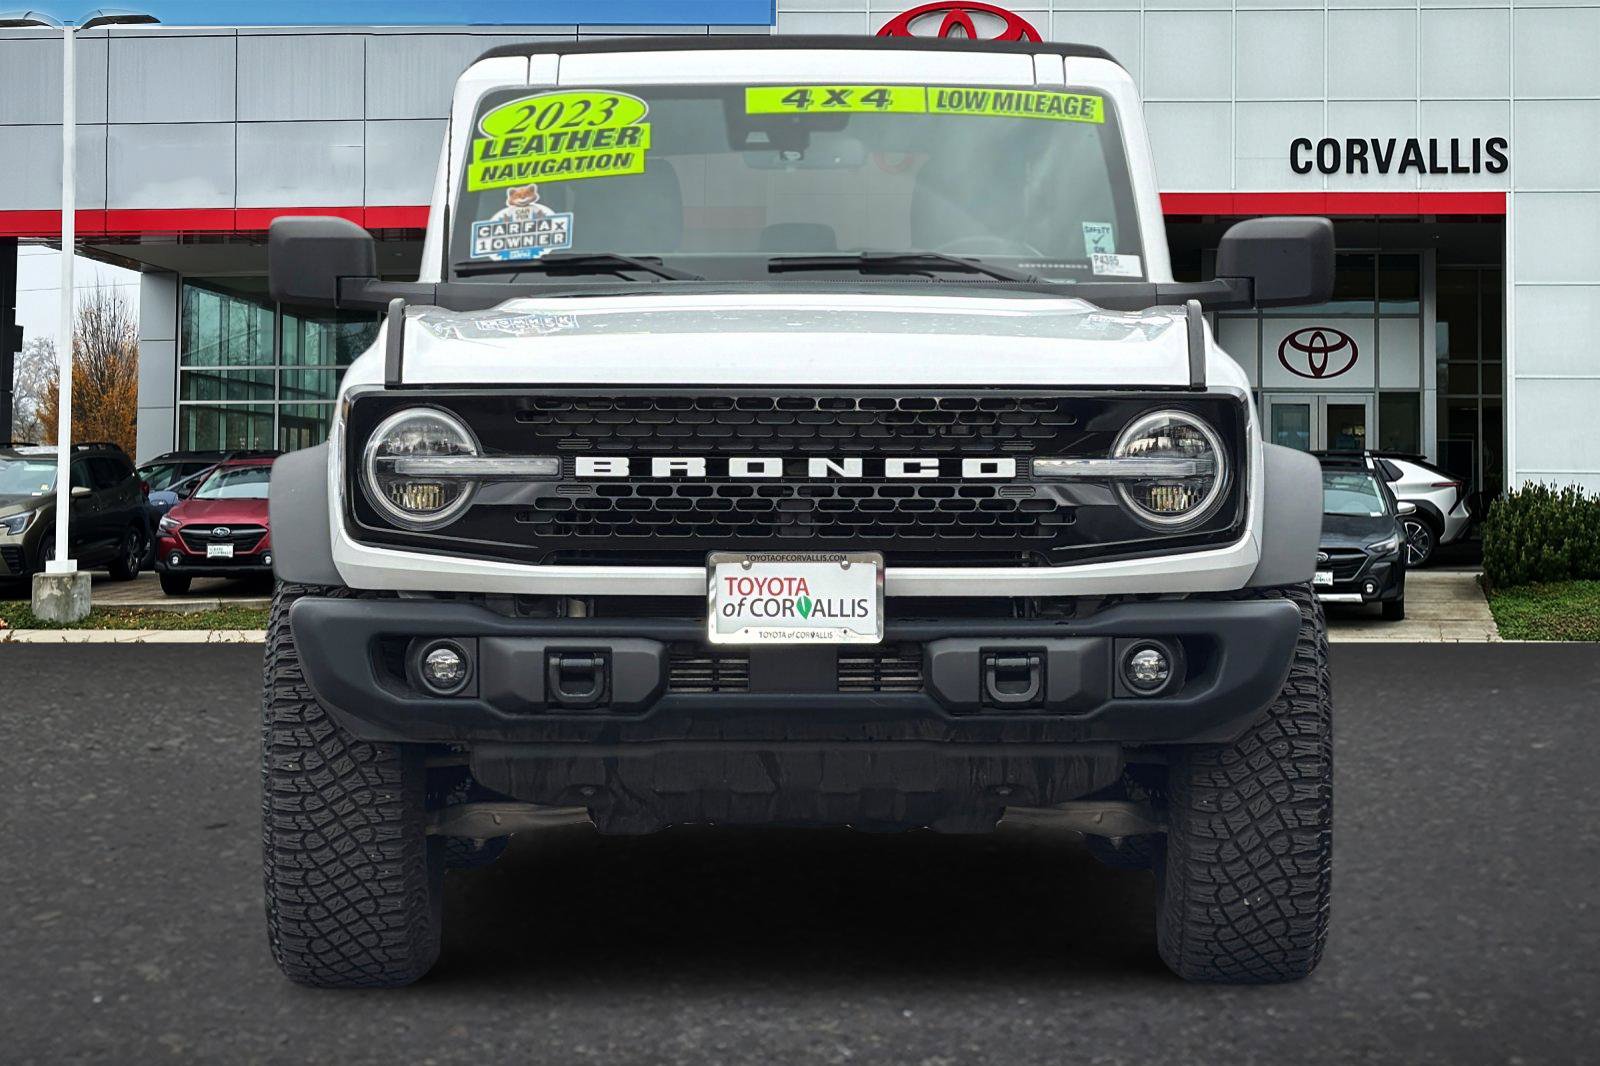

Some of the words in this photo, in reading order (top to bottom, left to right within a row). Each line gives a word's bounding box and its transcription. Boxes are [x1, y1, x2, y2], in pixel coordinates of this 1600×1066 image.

[505, 97, 619, 134] 2023
[936, 89, 989, 111] LOW
[990, 91, 1097, 119] MILEAGE
[480, 126, 643, 159] LEATHER
[480, 152, 633, 181] NAVIGATION
[1290, 137, 1508, 174] CORVALLIS
[479, 220, 565, 237] CARFAX
[575, 457, 1016, 477] BRONCO
[745, 554, 847, 562] TOYOTAOFCORVALLIS.COM
[724, 577, 810, 596] TOYOTA
[723, 597, 746, 617] of
